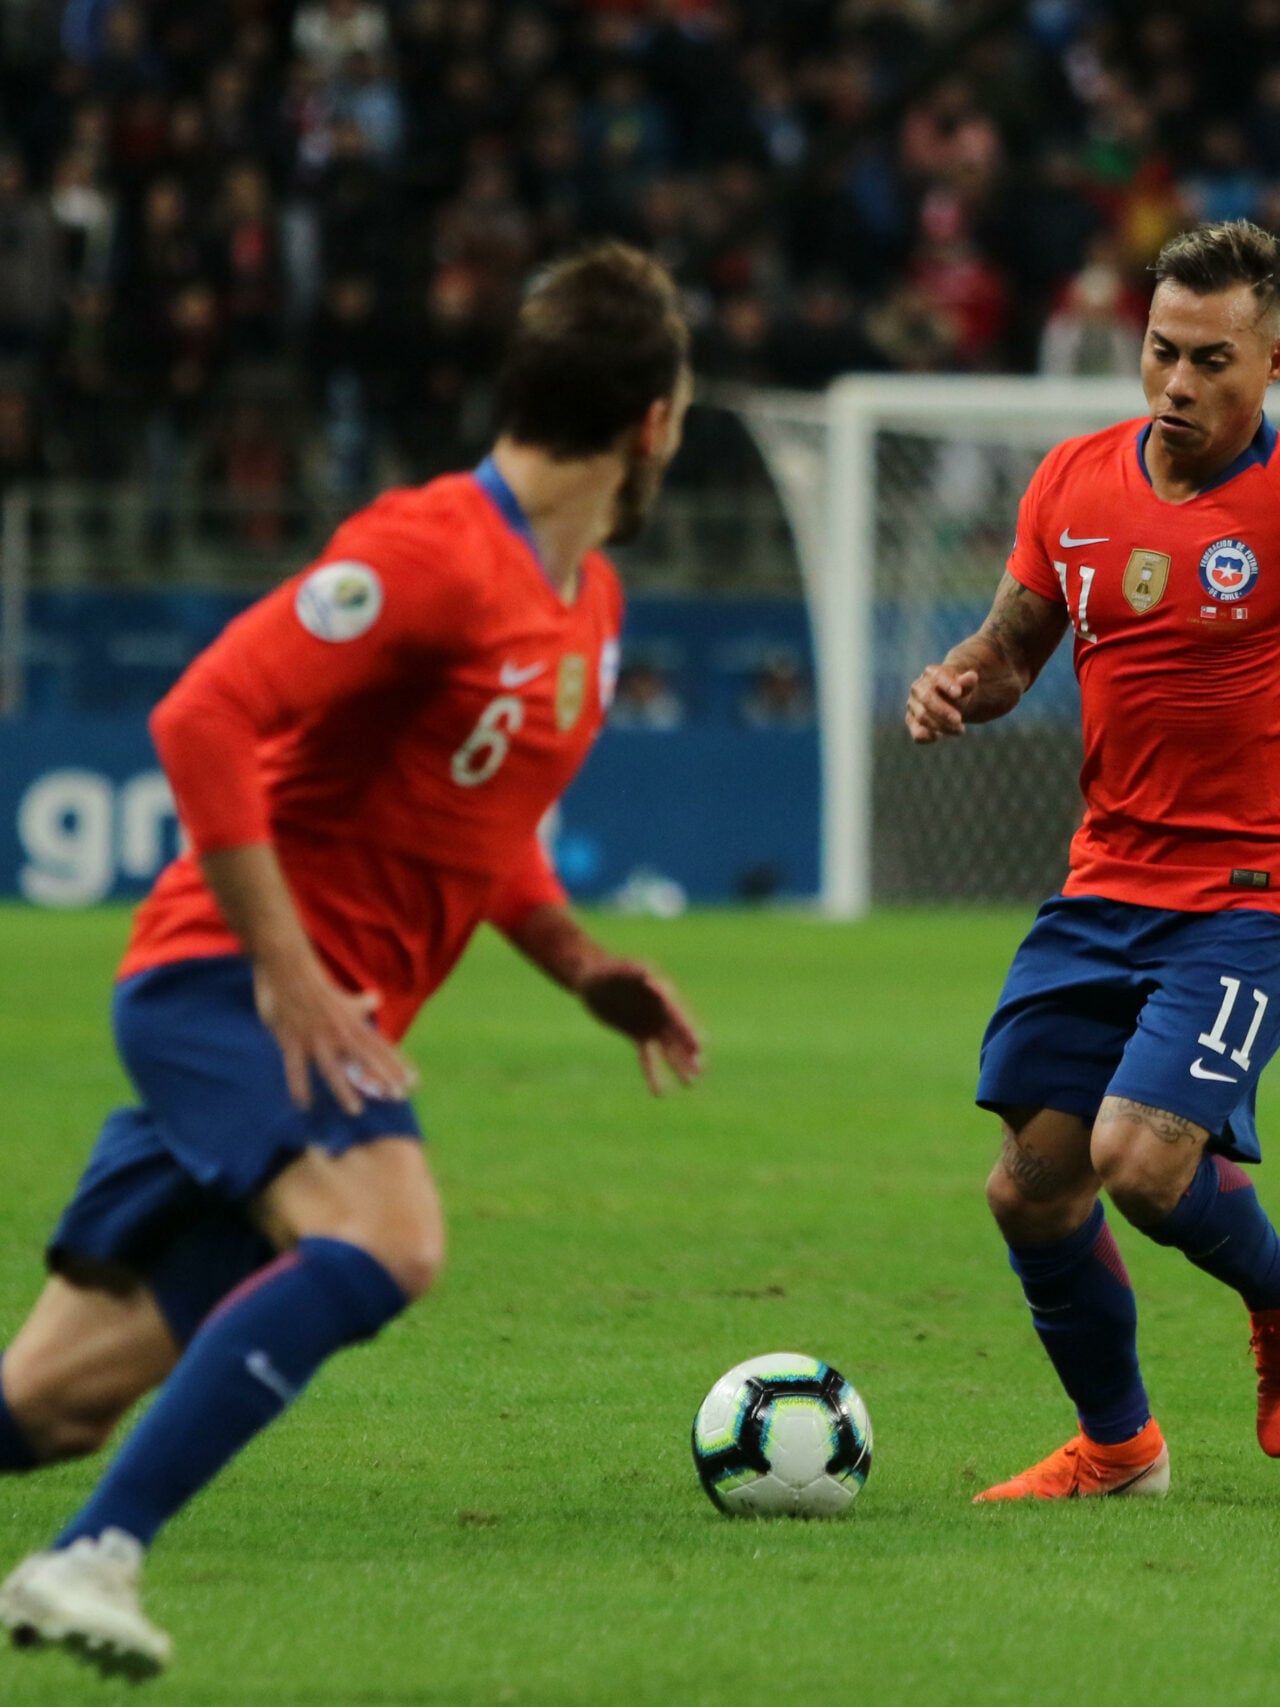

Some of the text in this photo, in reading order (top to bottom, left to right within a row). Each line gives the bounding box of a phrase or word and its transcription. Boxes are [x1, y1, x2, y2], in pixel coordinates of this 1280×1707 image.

[1053, 560, 1098, 645] 11
[450, 696, 525, 784] 6
[1197, 975, 1269, 1072] 11
